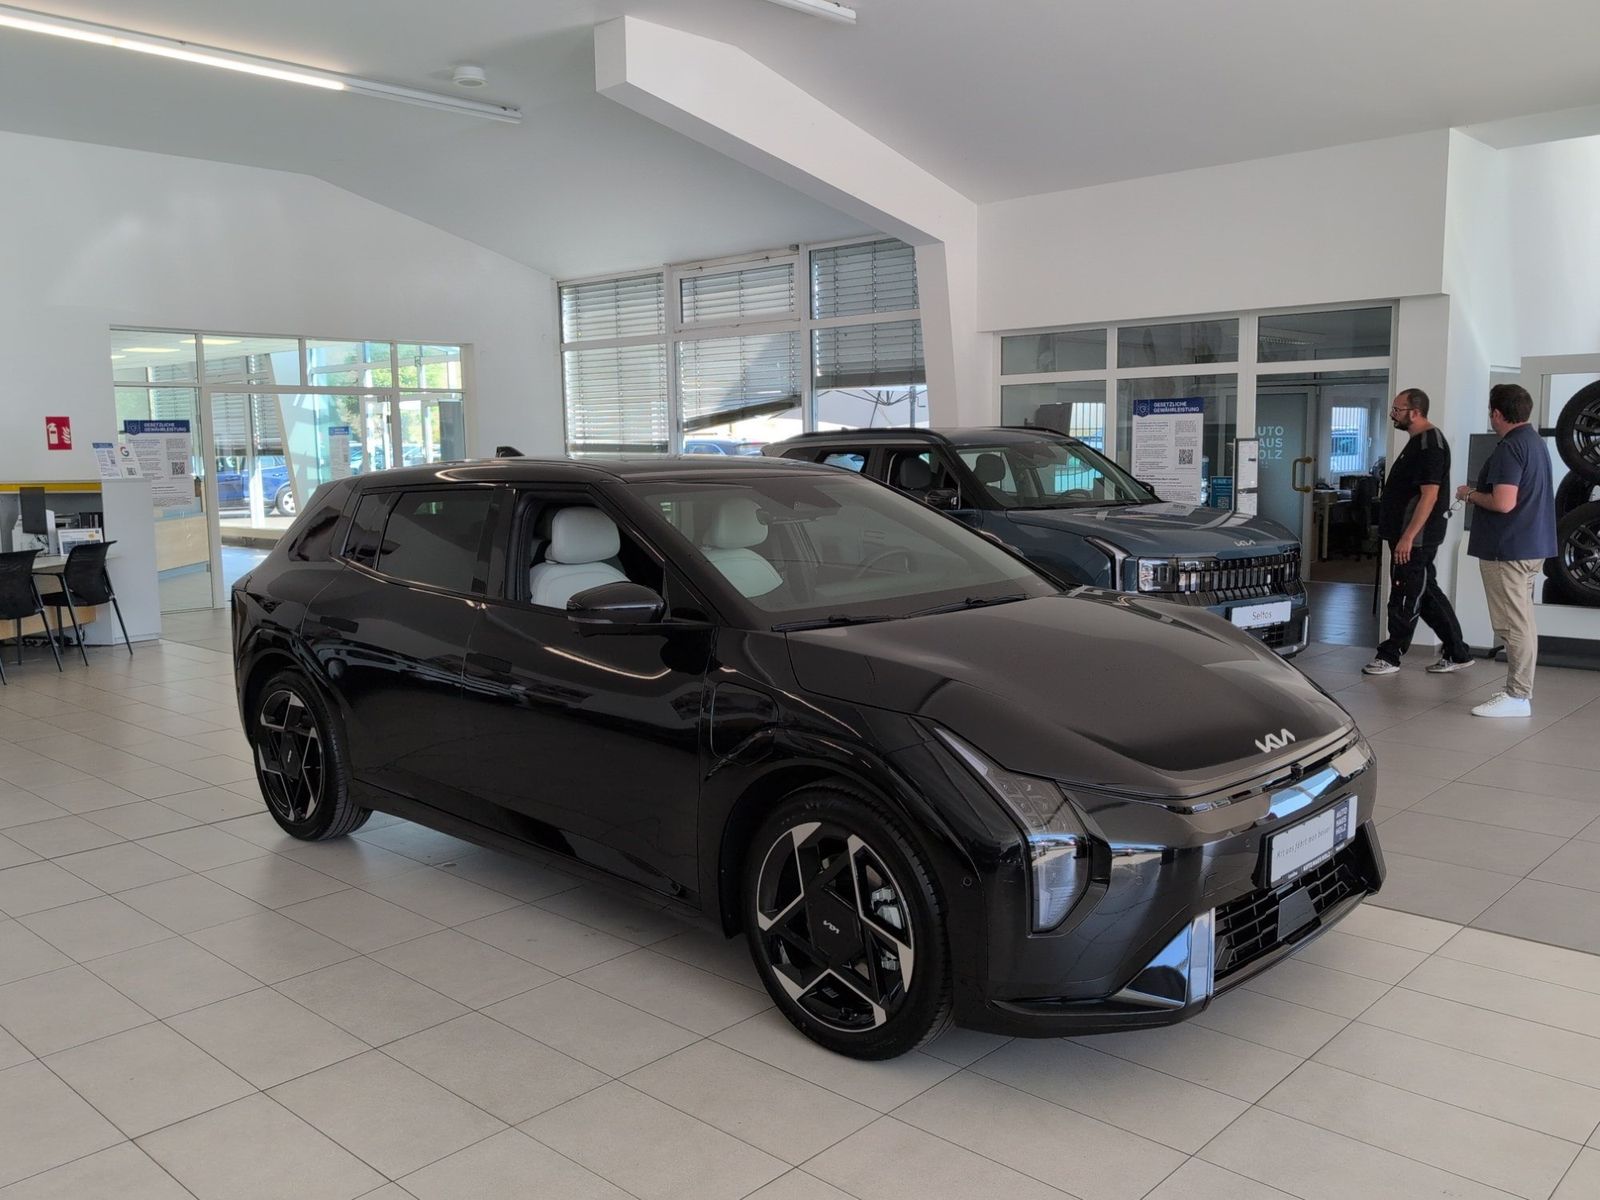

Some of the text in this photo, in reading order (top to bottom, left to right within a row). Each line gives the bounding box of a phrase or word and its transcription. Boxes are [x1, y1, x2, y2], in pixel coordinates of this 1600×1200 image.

[1257, 426, 1284, 436] UTO
[1259, 438, 1283, 448] AUS
[1258, 450, 1282, 459] OLZ
[1252, 611, 1272, 621] Seltos
[1254, 728, 1296, 753] KIA
